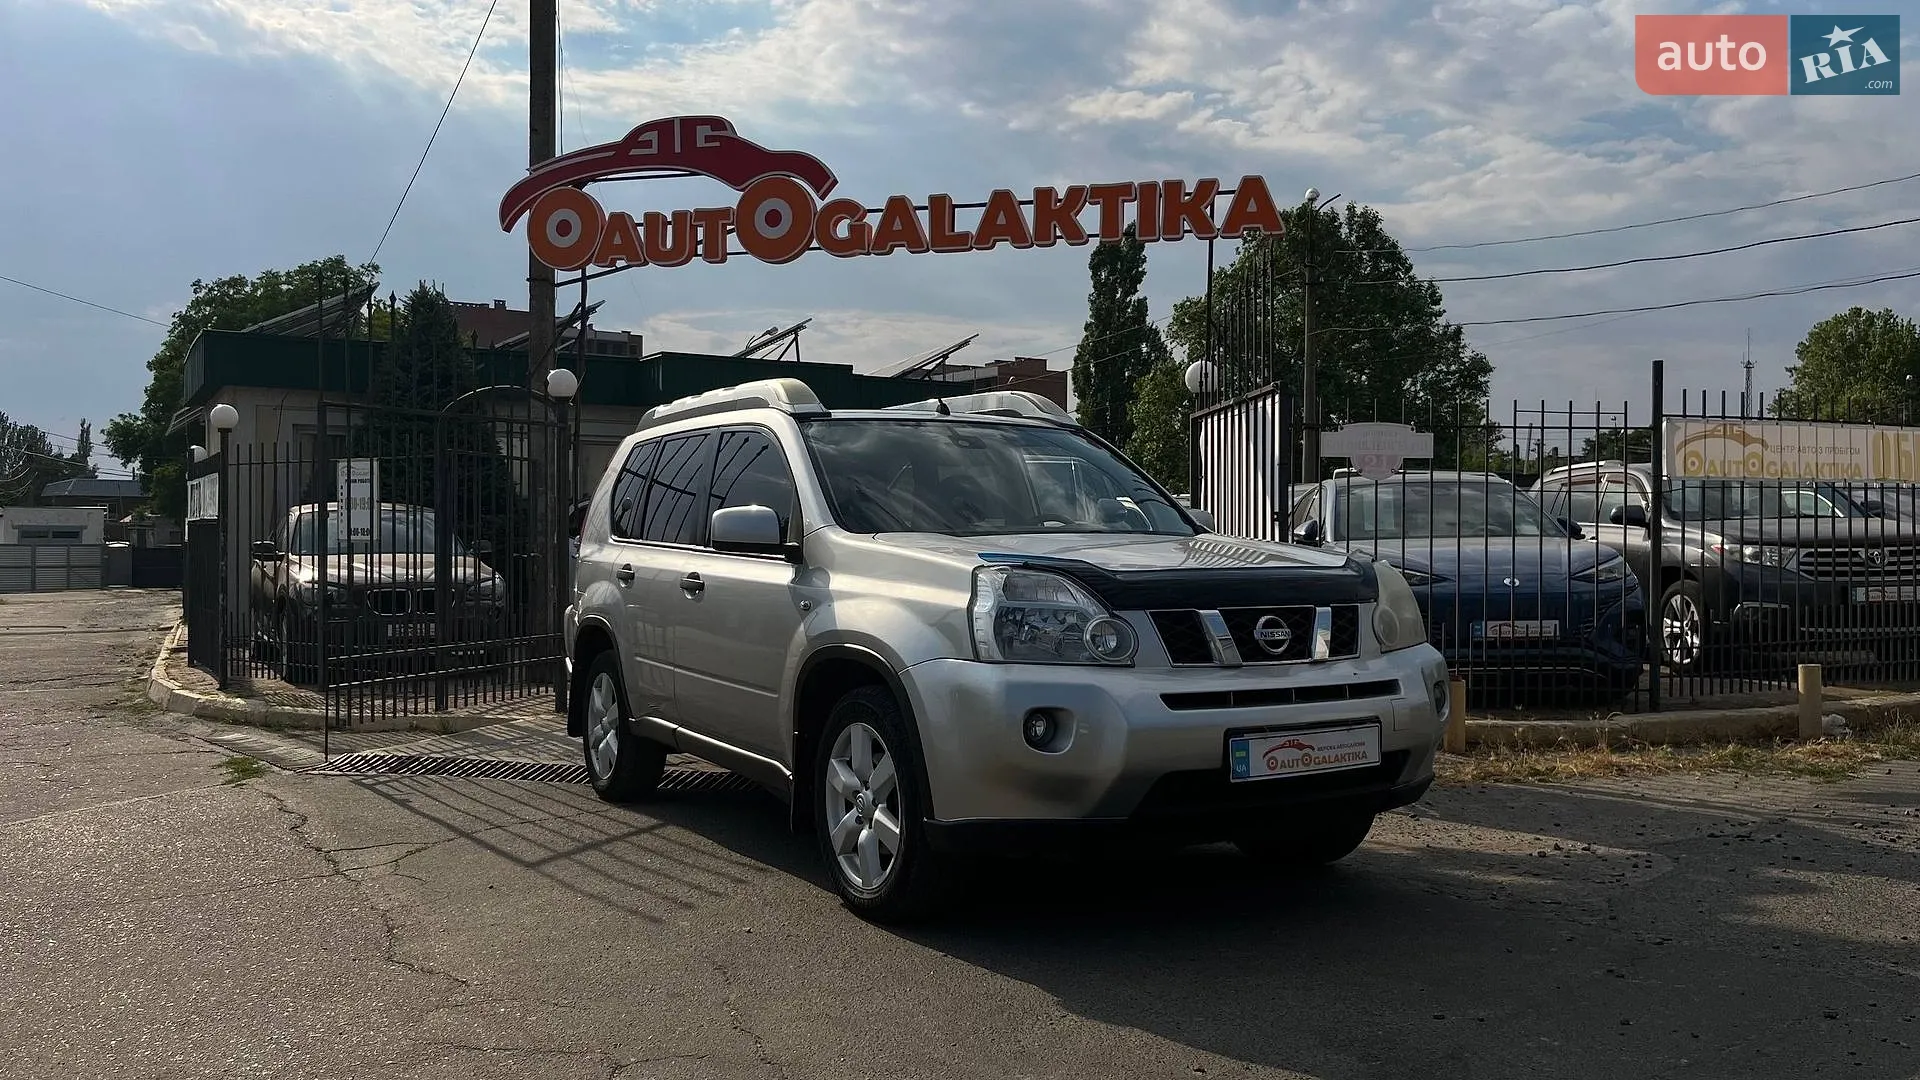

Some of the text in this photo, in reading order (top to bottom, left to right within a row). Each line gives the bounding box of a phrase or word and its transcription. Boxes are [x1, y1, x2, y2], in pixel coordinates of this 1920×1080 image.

[1769, 445, 1795, 455] ЦЕНТР
[1260, 630, 1291, 639] NISSAN
[1236, 764, 1247, 773] UA
